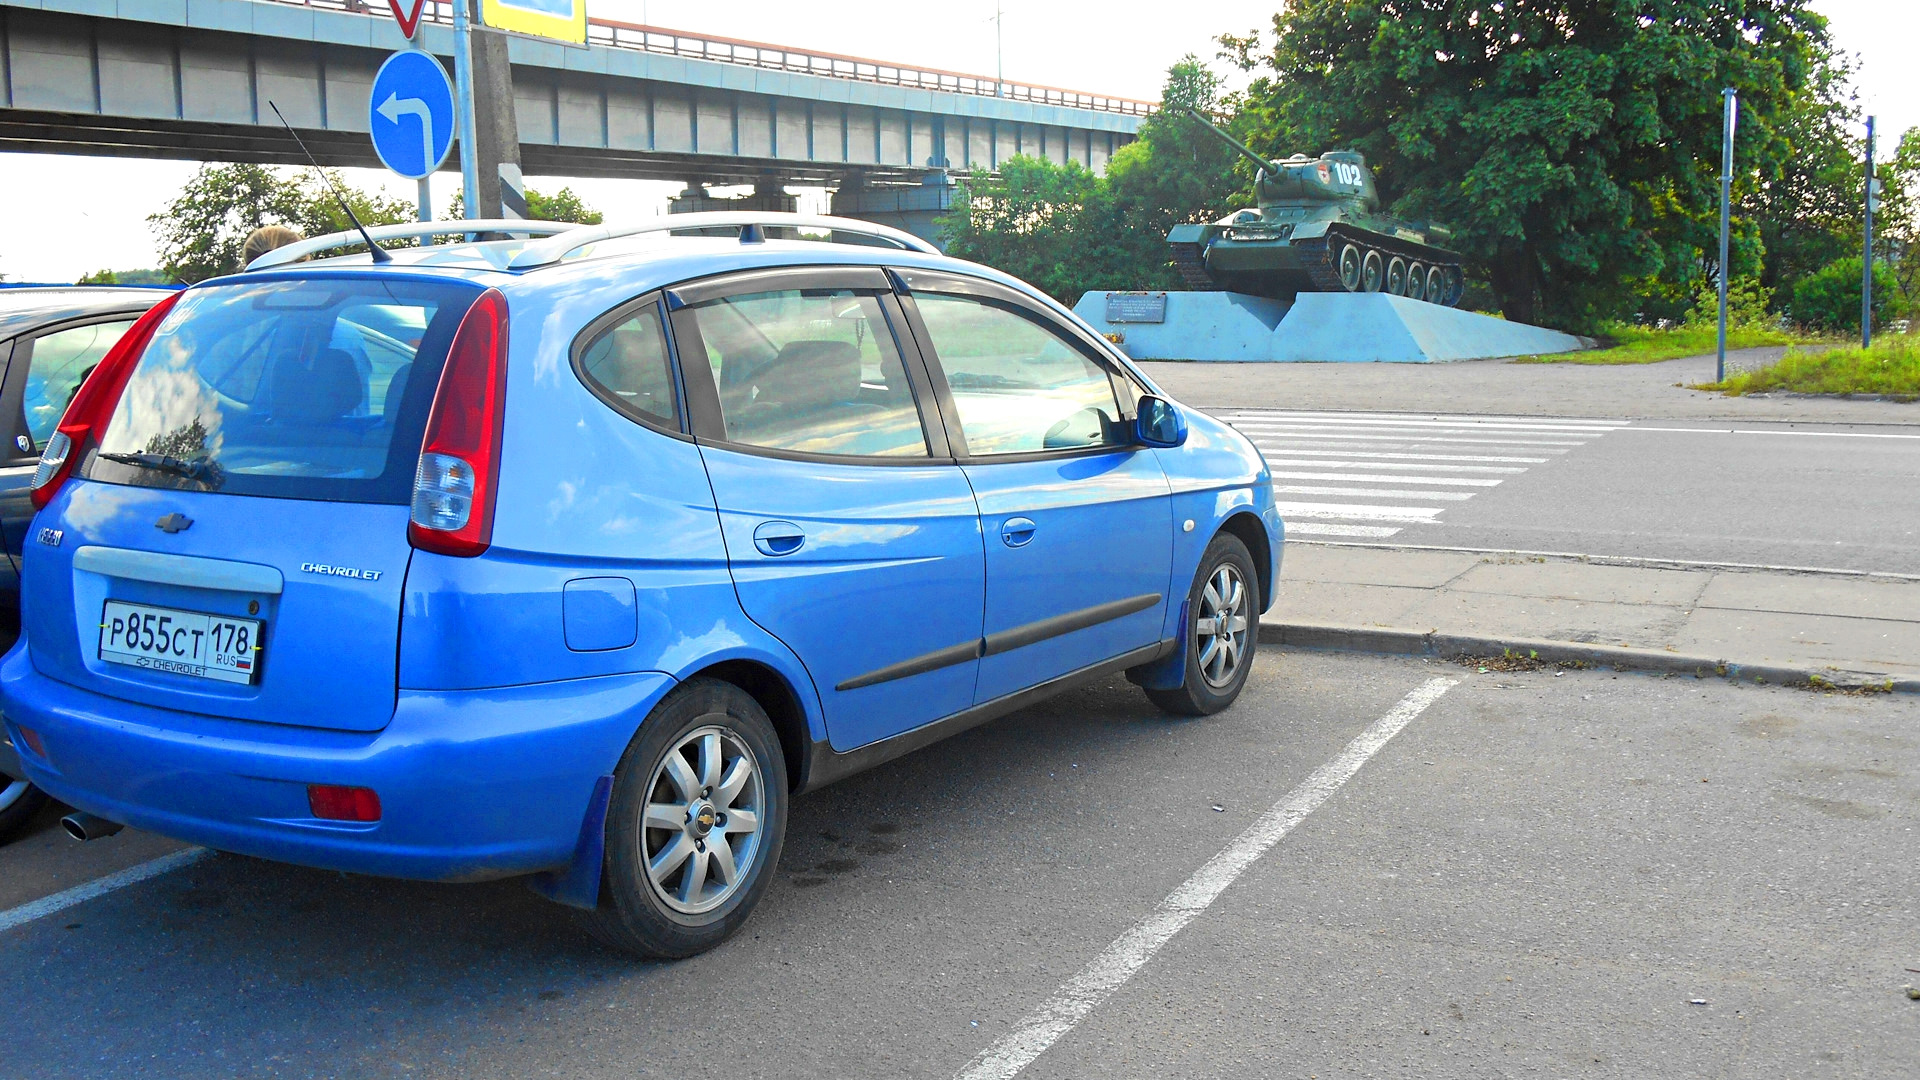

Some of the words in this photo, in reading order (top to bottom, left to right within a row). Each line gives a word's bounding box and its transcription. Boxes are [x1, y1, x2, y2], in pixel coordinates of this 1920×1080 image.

[1334, 162, 1363, 187] 102
[300, 562, 383, 581] CHEVROLET
[110, 612, 204, 659] P855CT
[211, 622, 249, 655] 178
[153, 659, 208, 677] CHEVROLET
[216, 653, 236, 666] RUS
